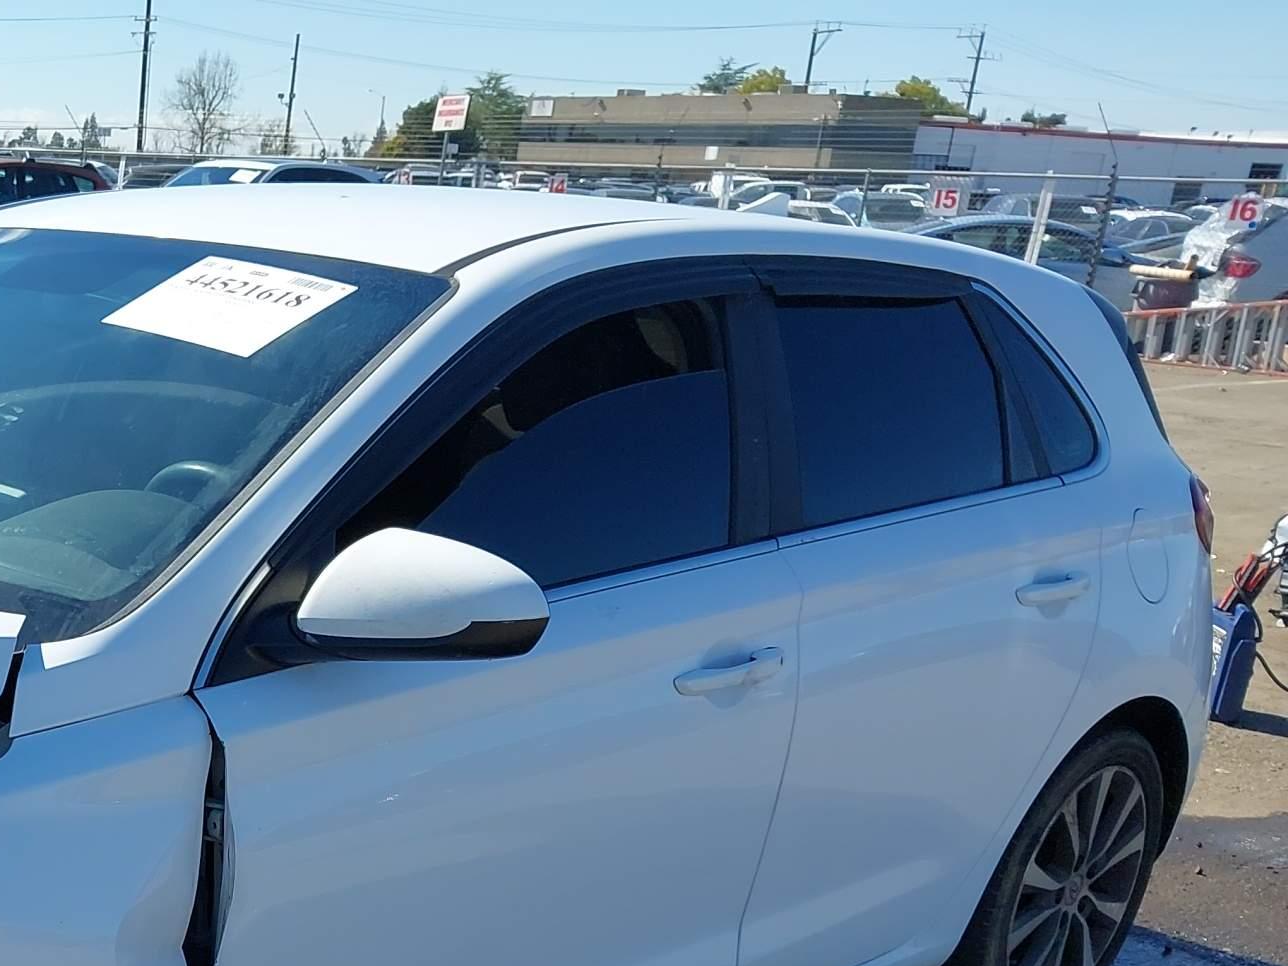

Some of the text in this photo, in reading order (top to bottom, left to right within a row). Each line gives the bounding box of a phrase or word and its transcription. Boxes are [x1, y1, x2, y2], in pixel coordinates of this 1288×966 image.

[934, 189, 958, 209] 15
[1228, 199, 1258, 222] 16
[184, 273, 312, 308] 44521618
